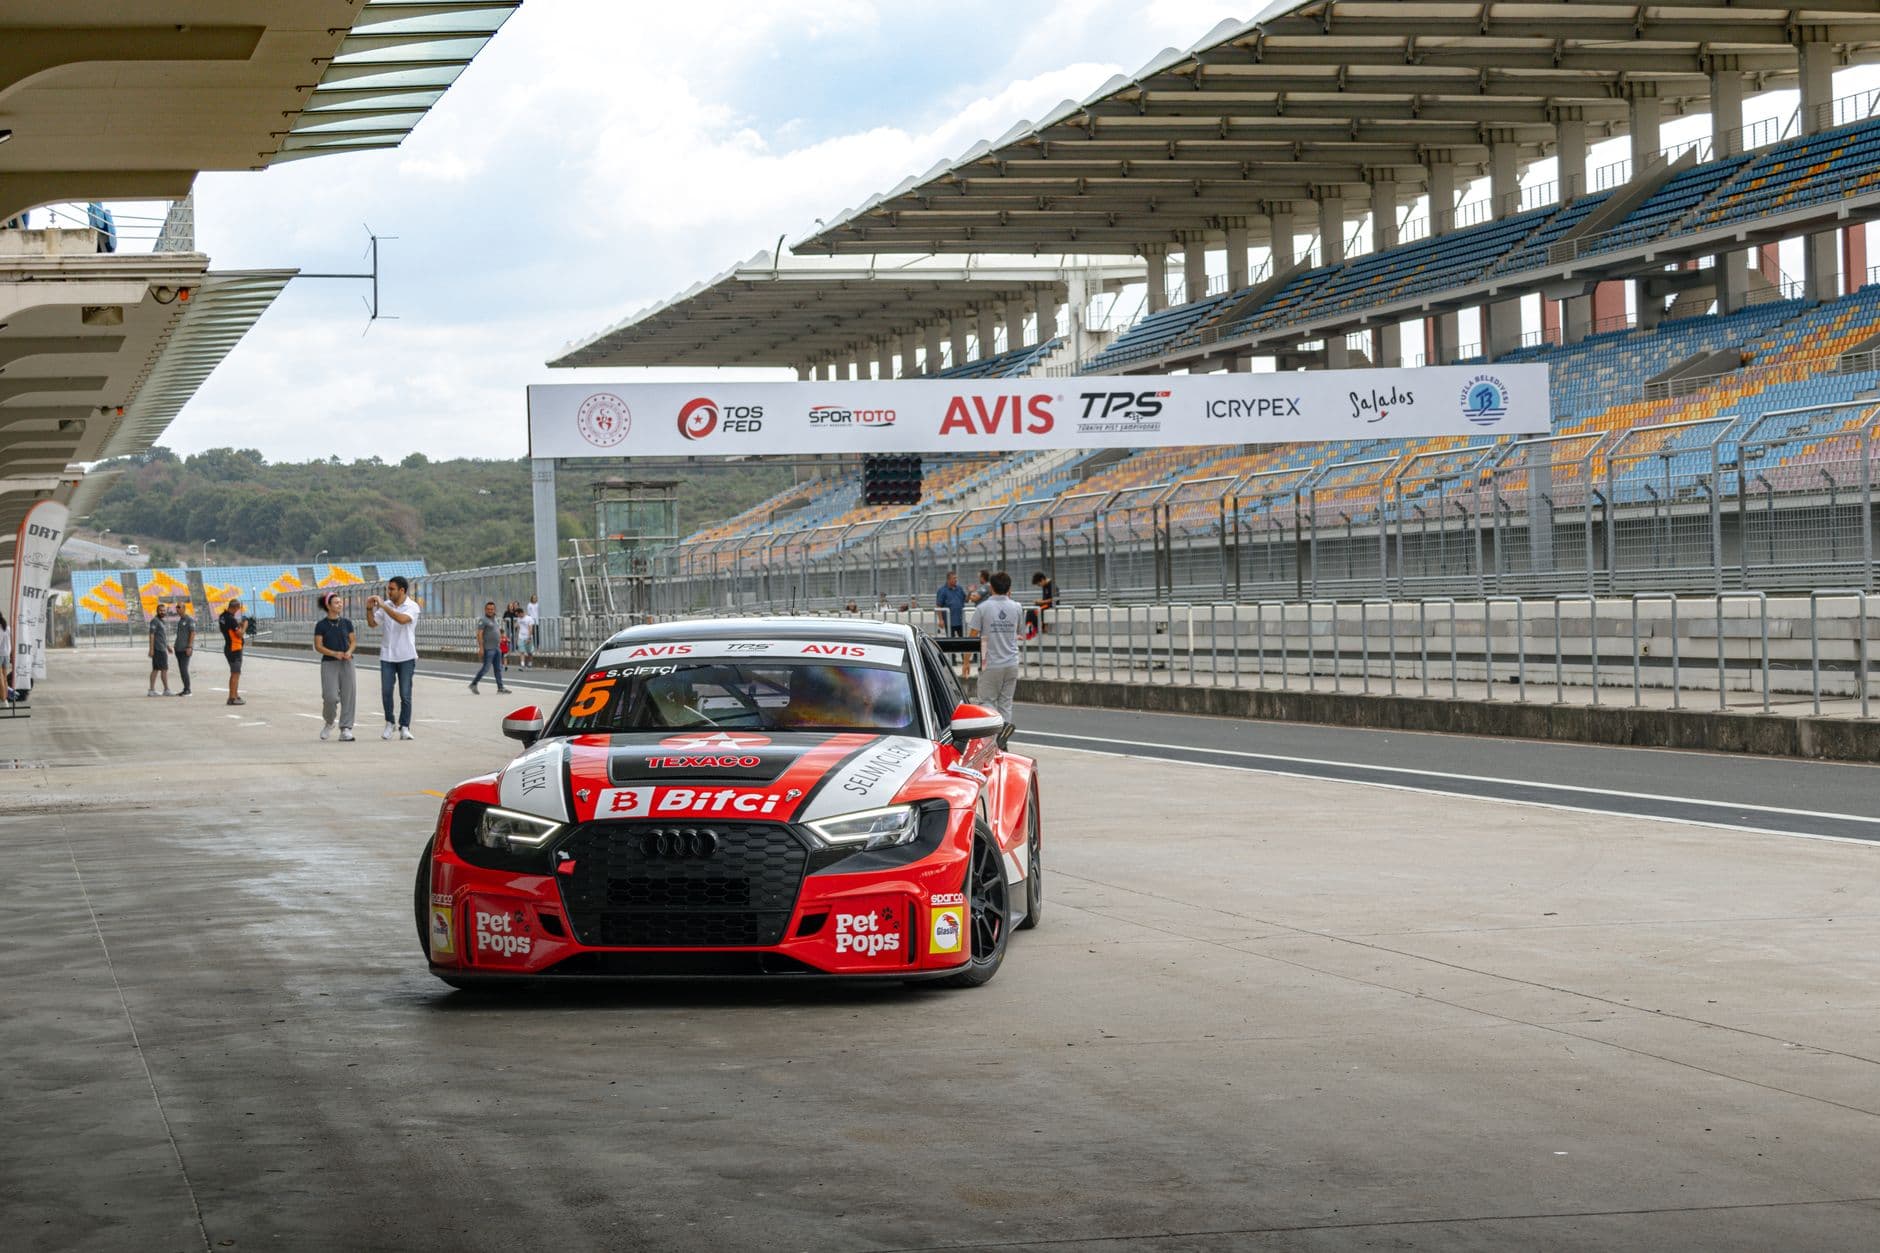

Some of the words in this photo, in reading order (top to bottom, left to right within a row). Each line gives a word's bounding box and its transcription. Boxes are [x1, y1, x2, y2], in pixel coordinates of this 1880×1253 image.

[1349, 386, 1414, 418] Salados
[1460, 380, 1475, 406] TUZLA
[722, 406, 764, 419] TOS
[938, 394, 1055, 435] AVIS
[1079, 391, 1163, 419] TPS
[1206, 397, 1301, 418] ICRYPEX
[722, 420, 762, 433] FED
[28, 523, 61, 541] DRT
[628, 645, 692, 658] AVIS
[801, 644, 866, 657] AVIS
[570, 678, 617, 718] 5
[645, 756, 761, 768] TEXACO
[656, 789, 780, 813] Bitci
[930, 893, 964, 904] sparco
[476, 912, 512, 932] Pet
[836, 910, 879, 932] Pet
[477, 932, 531, 957] Pops
[836, 933, 900, 957] Pops
